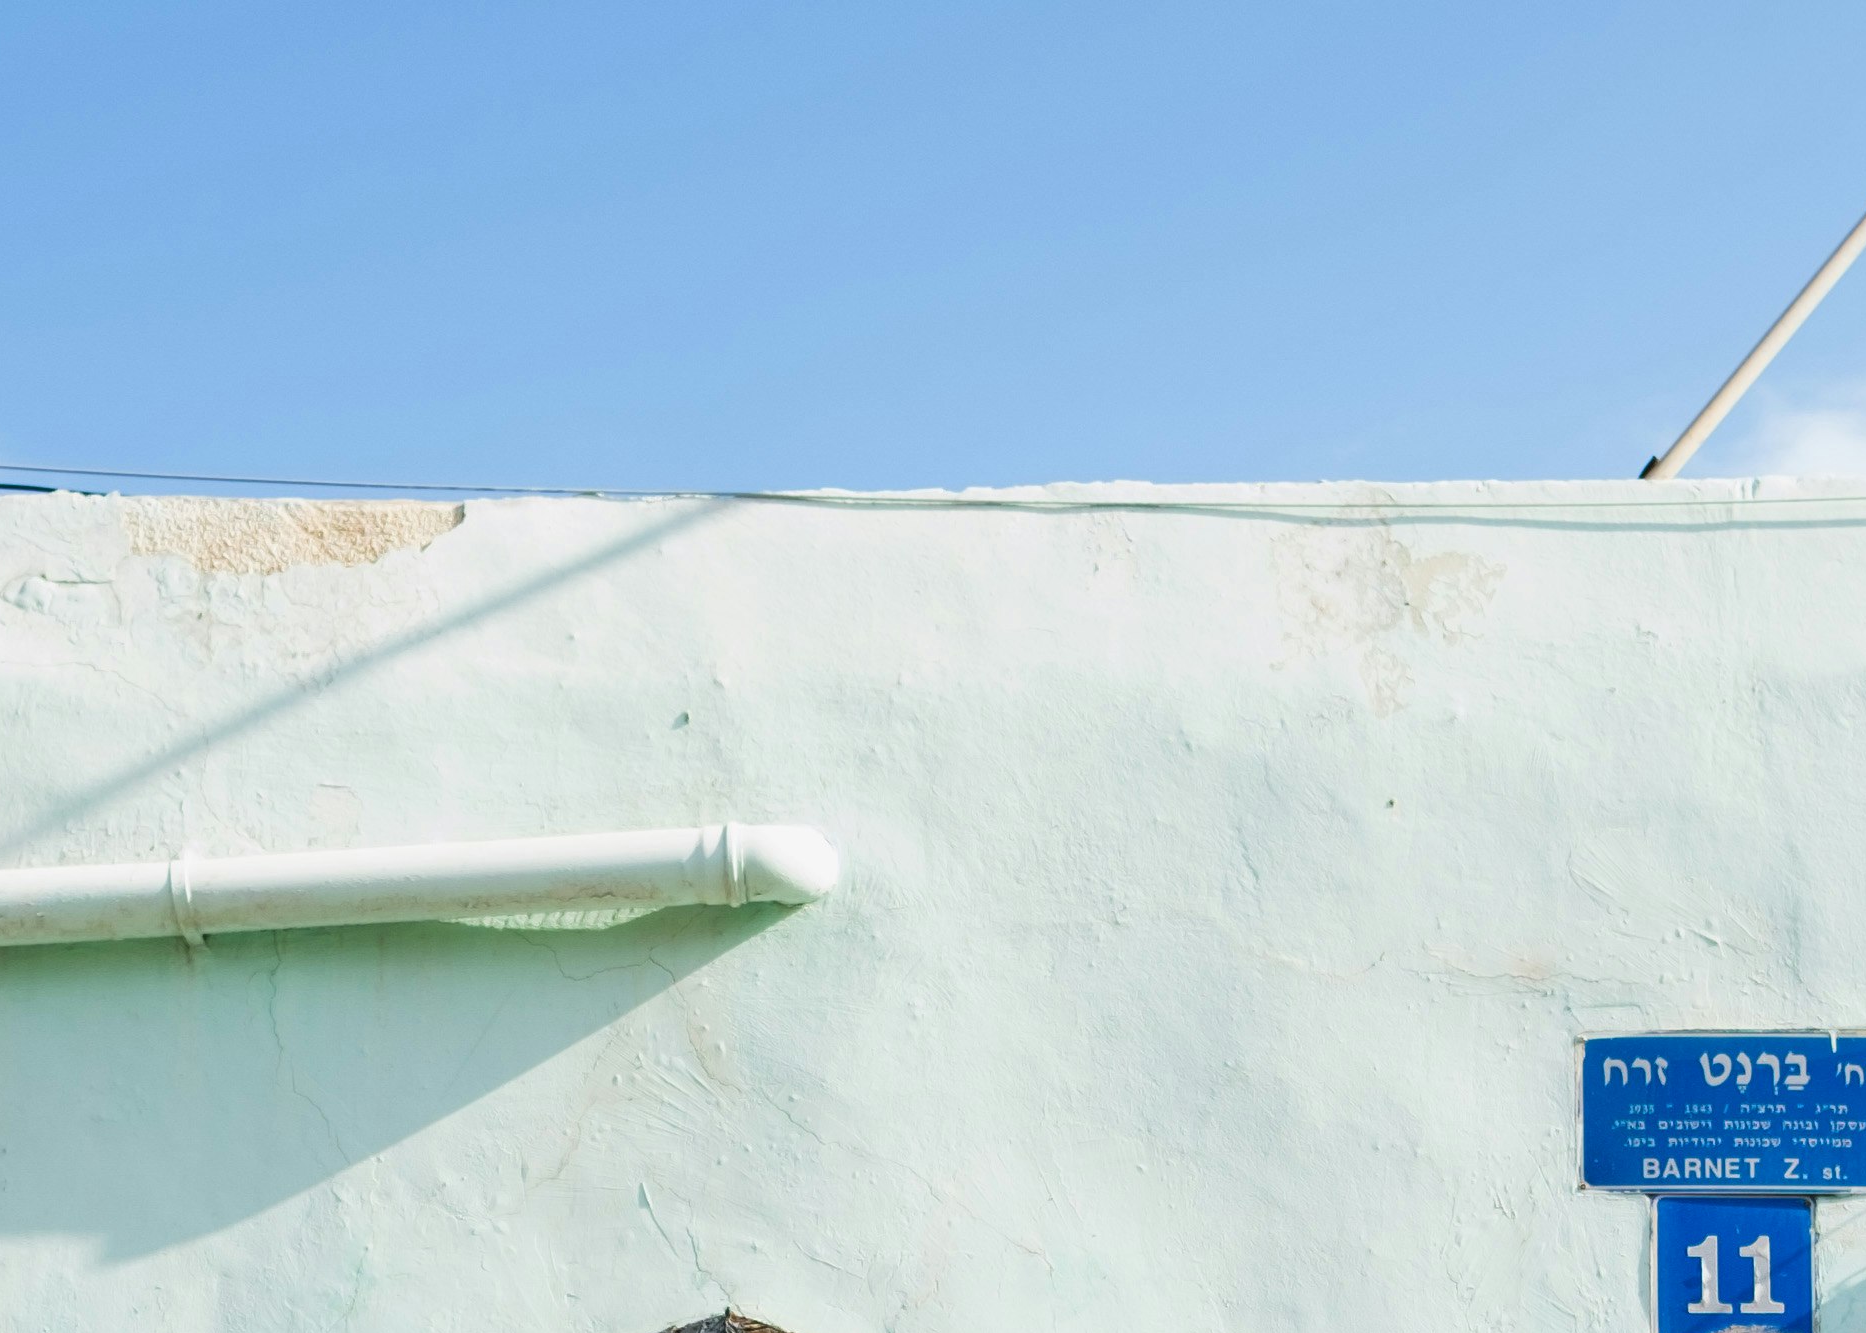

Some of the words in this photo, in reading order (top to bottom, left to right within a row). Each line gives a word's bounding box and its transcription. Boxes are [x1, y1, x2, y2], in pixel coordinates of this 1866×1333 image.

[1603, 1056, 1668, 1087] זרח
[1643, 1157, 1760, 1180] BARNET
[1784, 1158, 1809, 1180] Z.
[1822, 1165, 1848, 1180] st.
[1687, 1235, 1785, 1314] 11
